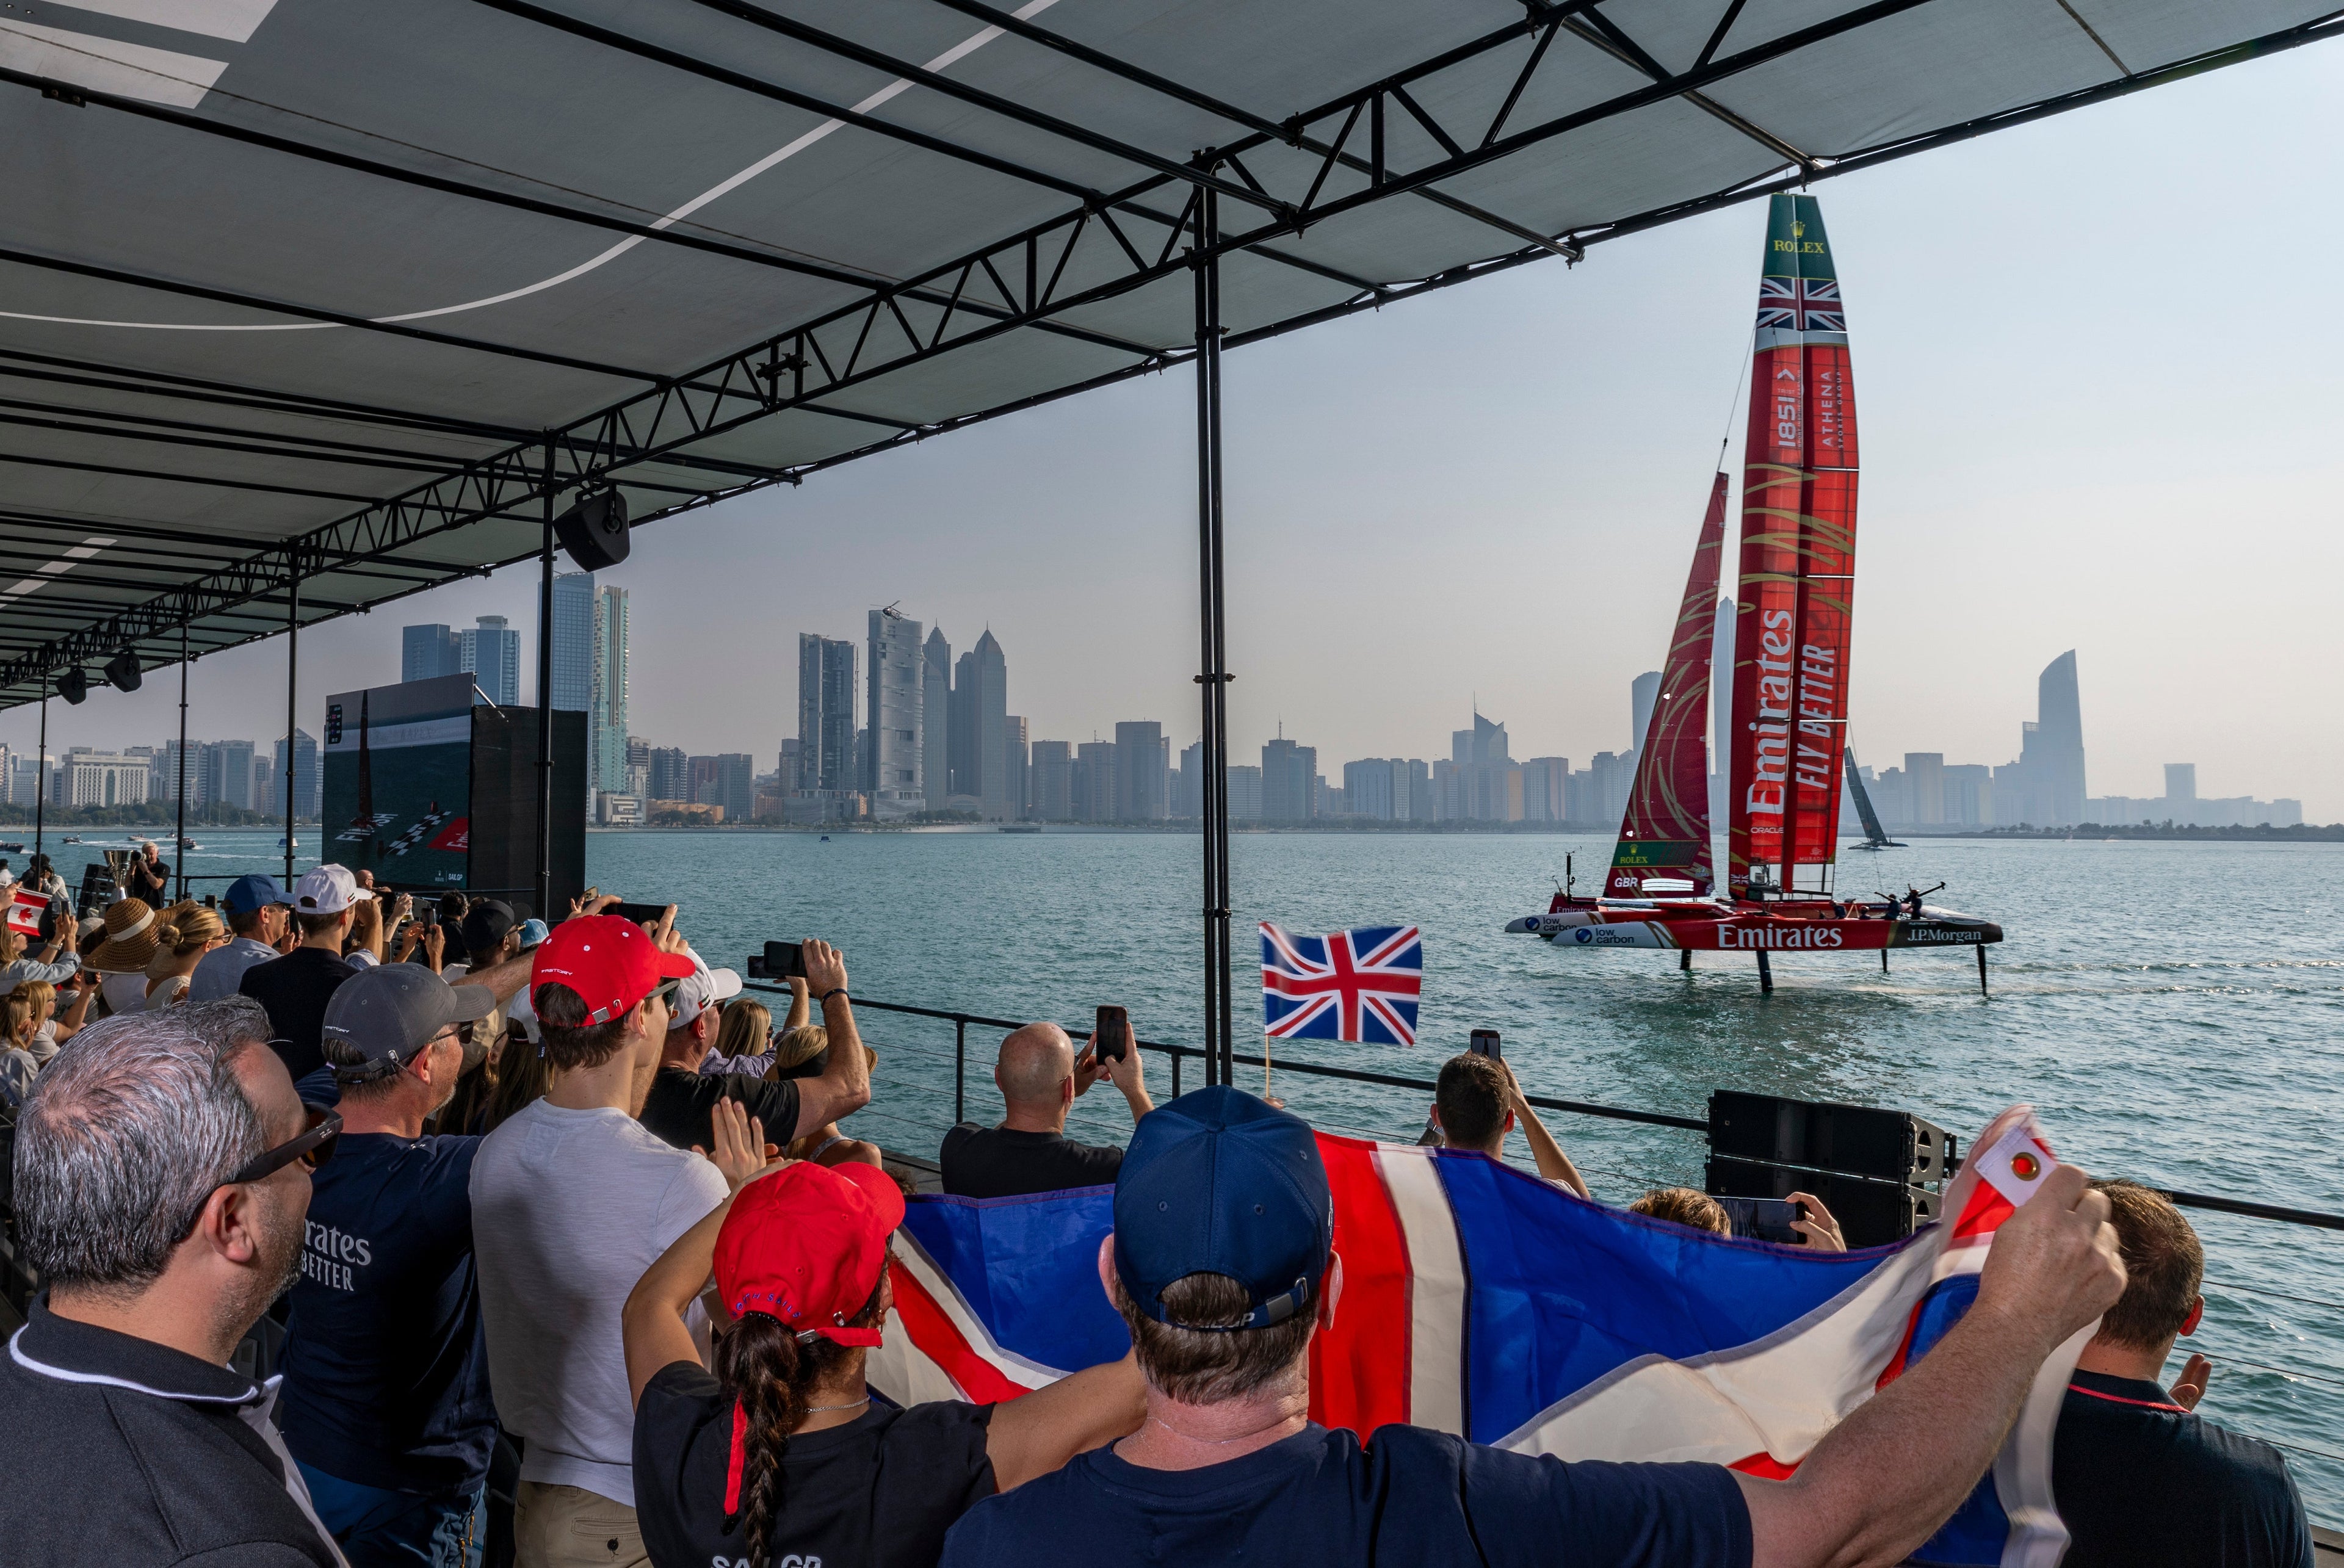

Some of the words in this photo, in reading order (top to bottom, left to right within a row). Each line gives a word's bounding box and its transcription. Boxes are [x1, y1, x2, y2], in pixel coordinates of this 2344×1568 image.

[1774, 240, 1825, 254] ROLEX
[1778, 396, 1796, 447] 1851
[1820, 371, 1834, 447] ATHENA
[1798, 644, 1835, 738] BETTER
[1746, 610, 1793, 815] Emirates
[1795, 743, 1830, 789] FLY
[1614, 877, 1638, 887] GBR
[1595, 928, 1615, 936] low
[1596, 934, 1635, 944] carbon
[1718, 924, 1842, 948] Emirates
[767, 1293, 801, 1318] SAILS
